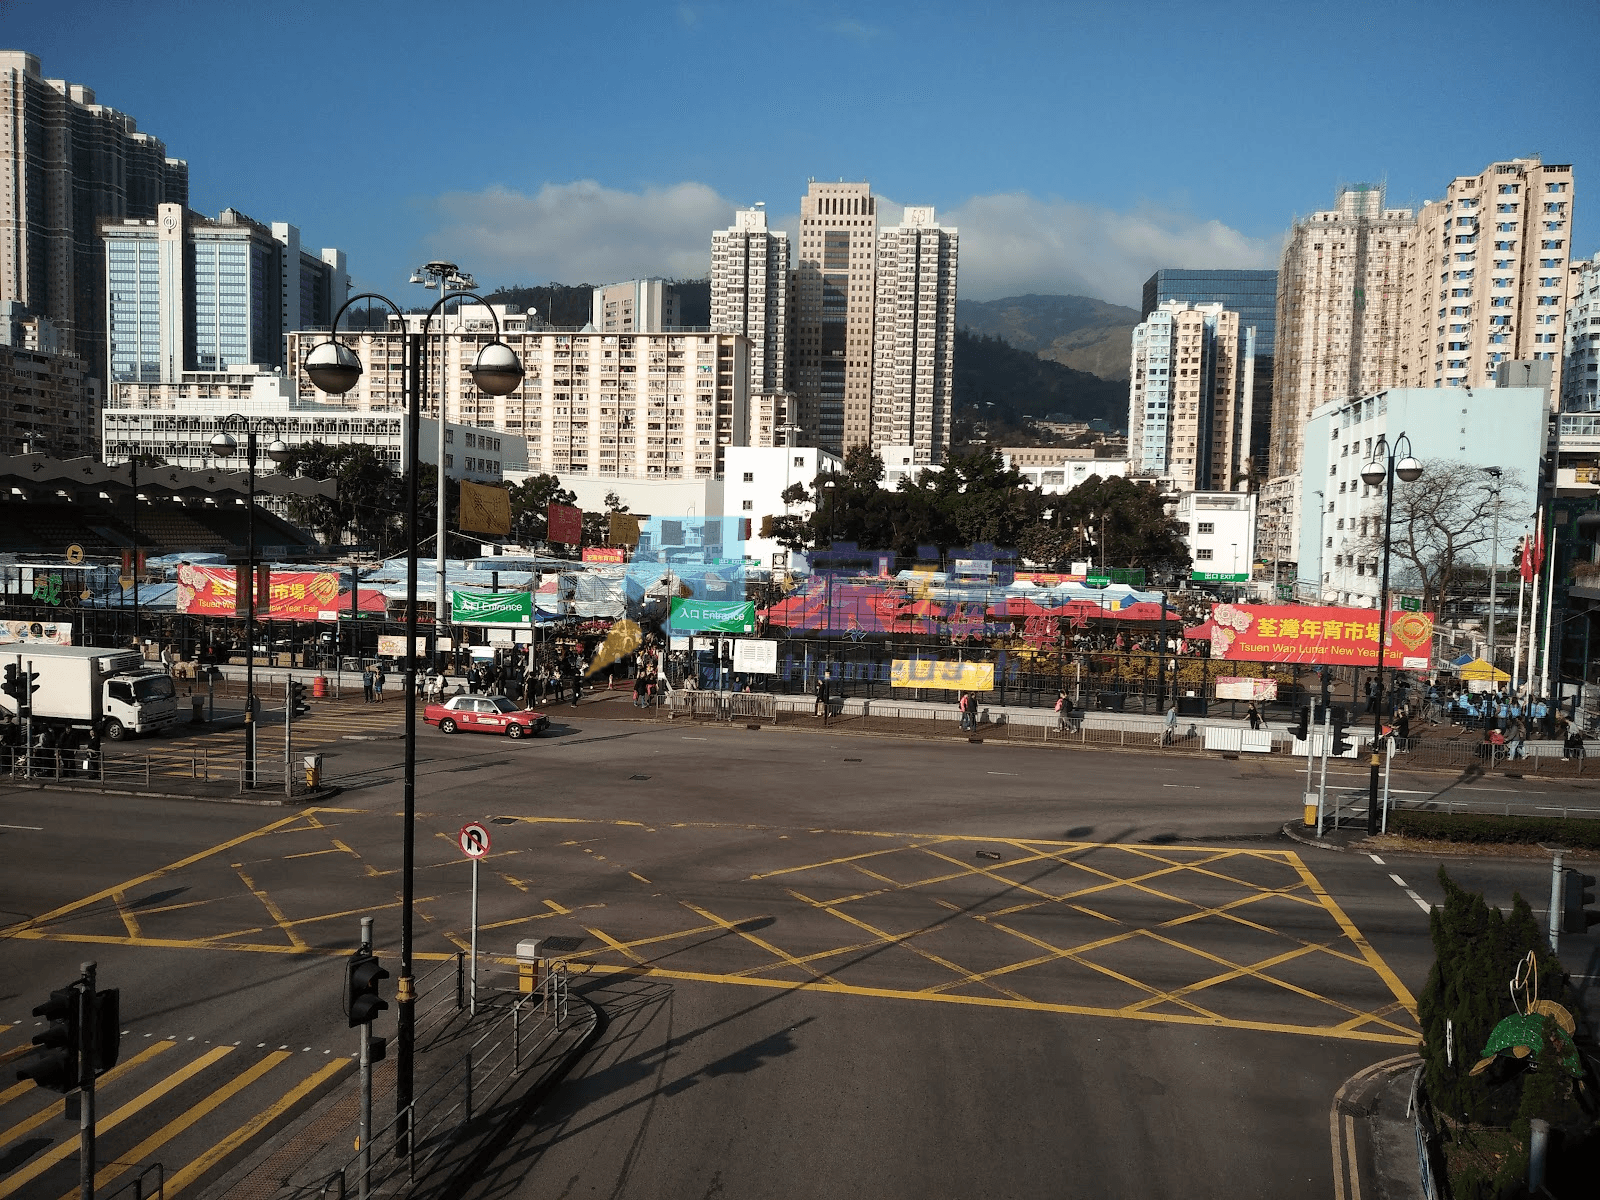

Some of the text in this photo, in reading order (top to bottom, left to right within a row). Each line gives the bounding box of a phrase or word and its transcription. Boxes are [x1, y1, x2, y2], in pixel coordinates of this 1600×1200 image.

[1204, 572, 1219, 580] 出口
[211, 581, 305, 600] 荃市場
[198, 598, 220, 609] Tsuen
[284, 604, 302, 613] Year
[303, 605, 319, 613] Fair
[482, 602, 522, 612] Entrance
[679, 607, 745, 621] 入口 Entrance
[1257, 617, 1387, 644] 荃灣年宵市場
[1239, 642, 1403, 659] Tsuen Wan Lunar New Year Fair
